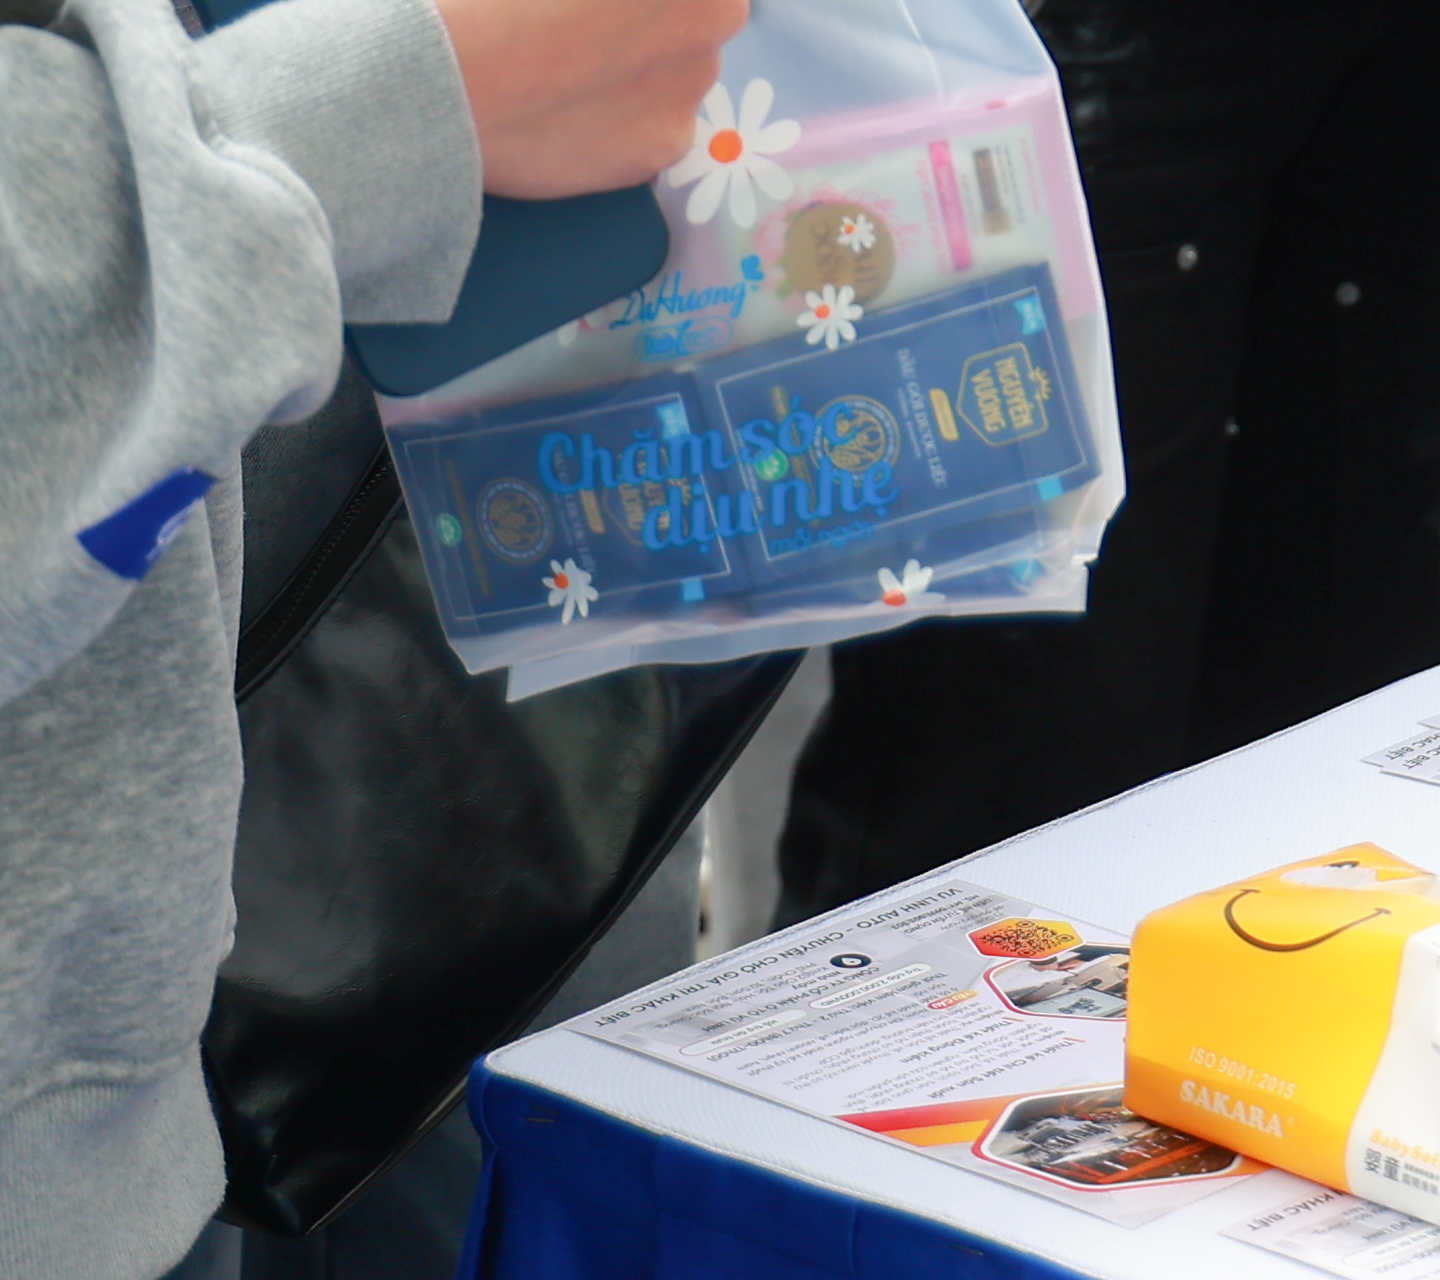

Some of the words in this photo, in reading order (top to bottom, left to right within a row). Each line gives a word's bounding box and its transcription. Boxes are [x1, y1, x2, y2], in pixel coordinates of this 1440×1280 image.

[966, 365, 1007, 434] VƯƠNG
[994, 355, 1033, 432] NGUYÊN
[538, 431, 730, 494] Chăm
[739, 395, 863, 466] sóc
[641, 487, 757, 555] dịu
[770, 449, 901, 532] nhẹ
[936, 888, 962, 898] VU
[900, 896, 937, 912] LINH
[856, 910, 899, 928] AUTO
[779, 932, 843, 958] CHUYÊN
[740, 956, 778, 973] CHỞ
[706, 971, 738, 985] GIÁ
[676, 983, 708, 995] TRỊ
[630, 993, 679, 1012] KHÁC
[595, 1011, 630, 1026] BIỆT
[980, 1020, 1012, 1032] Thiết
[963, 1031, 982, 1040] kế
[1041, 1041, 1073, 1053] Thiết
[900, 1050, 931, 1062] kiểm
[1024, 1052, 1043, 1061] kế
[1003, 1059, 1026, 1069] Chi
[981, 1067, 1004, 1077] tiết
[1189, 1046, 1216, 1068] ISO
[1219, 1058, 1297, 1099] 9001:2015
[956, 1076, 983, 1086] Sản
[928, 1085, 955, 1098] xuất
[1183, 1081, 1285, 1137] SAKARA
[1292, 1192, 1335, 1212] KHÁC
[1248, 1213, 1284, 1230] BIỆT
